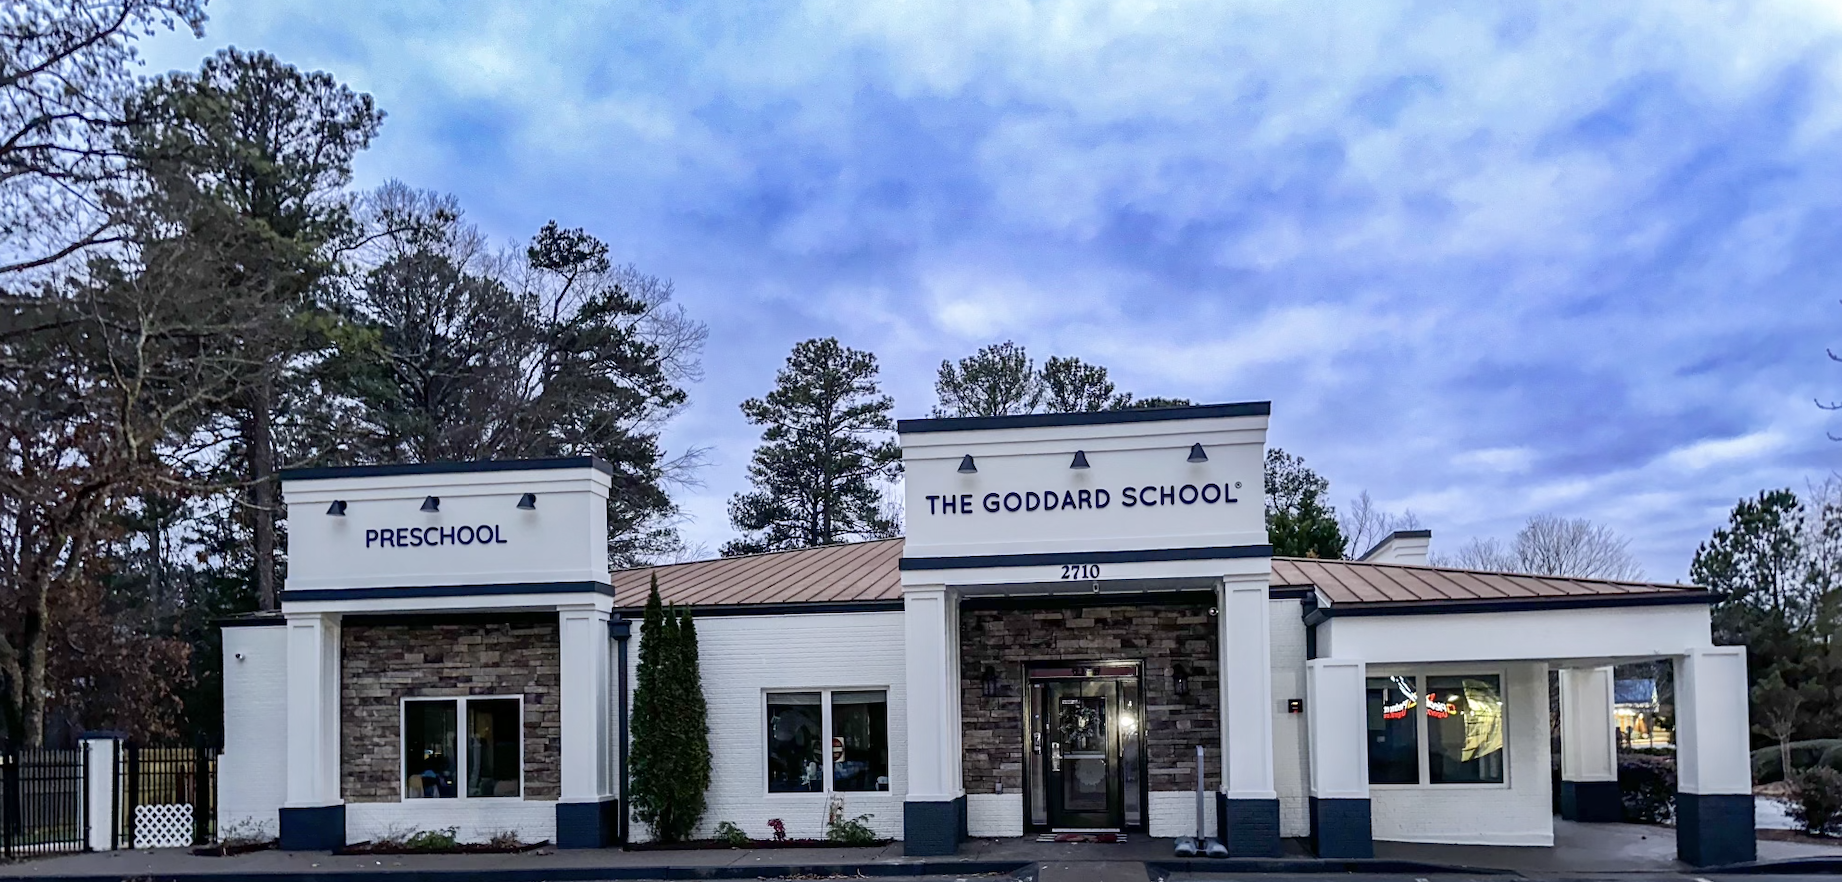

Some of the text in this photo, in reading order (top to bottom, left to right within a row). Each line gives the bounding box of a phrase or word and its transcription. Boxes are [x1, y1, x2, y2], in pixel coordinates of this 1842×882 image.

[925, 494, 973, 515] THE
[982, 489, 1111, 514] GODDARD
[365, 524, 508, 549] PRESCHOOL
[1061, 564, 1100, 580] 2710
